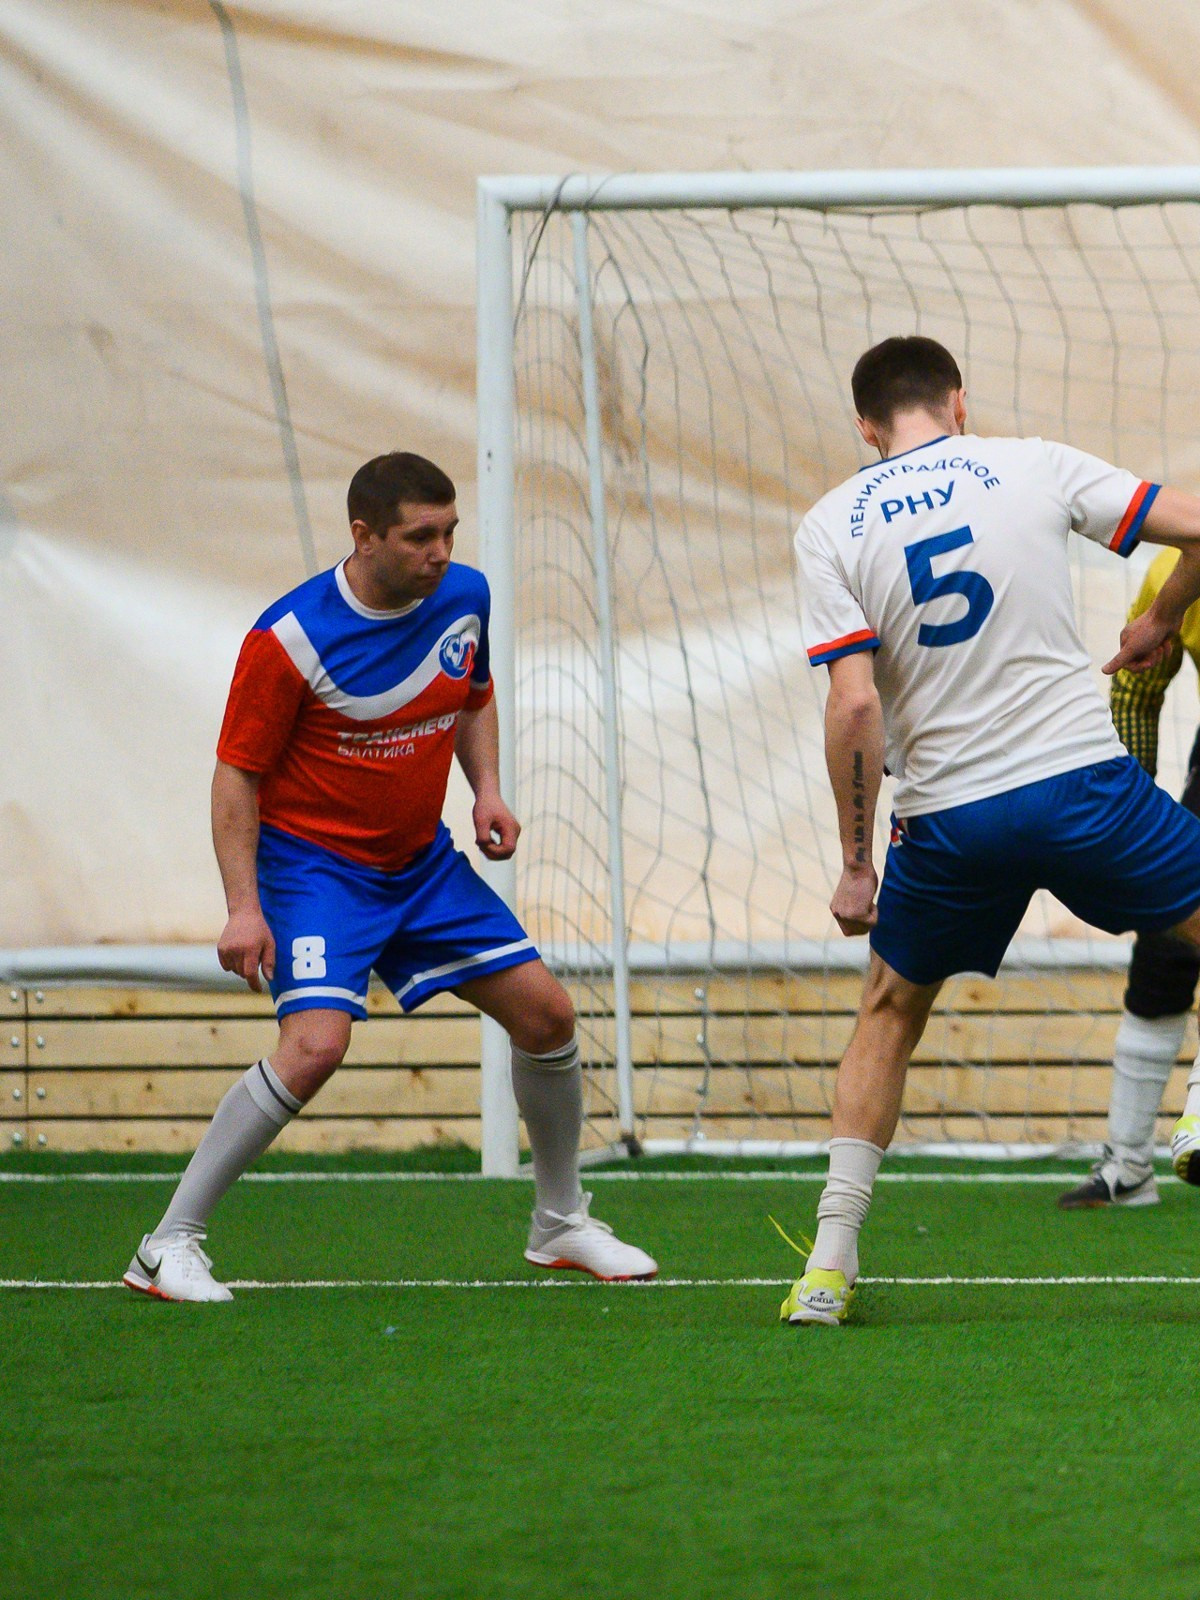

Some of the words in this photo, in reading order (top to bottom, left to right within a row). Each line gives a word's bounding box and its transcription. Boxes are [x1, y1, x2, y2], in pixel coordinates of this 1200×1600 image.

[880, 480, 955, 523] РНУ
[904, 525, 994, 647] 5
[337, 713, 456, 745] ТРАНСНЕФ
[292, 936, 326, 979] 8
